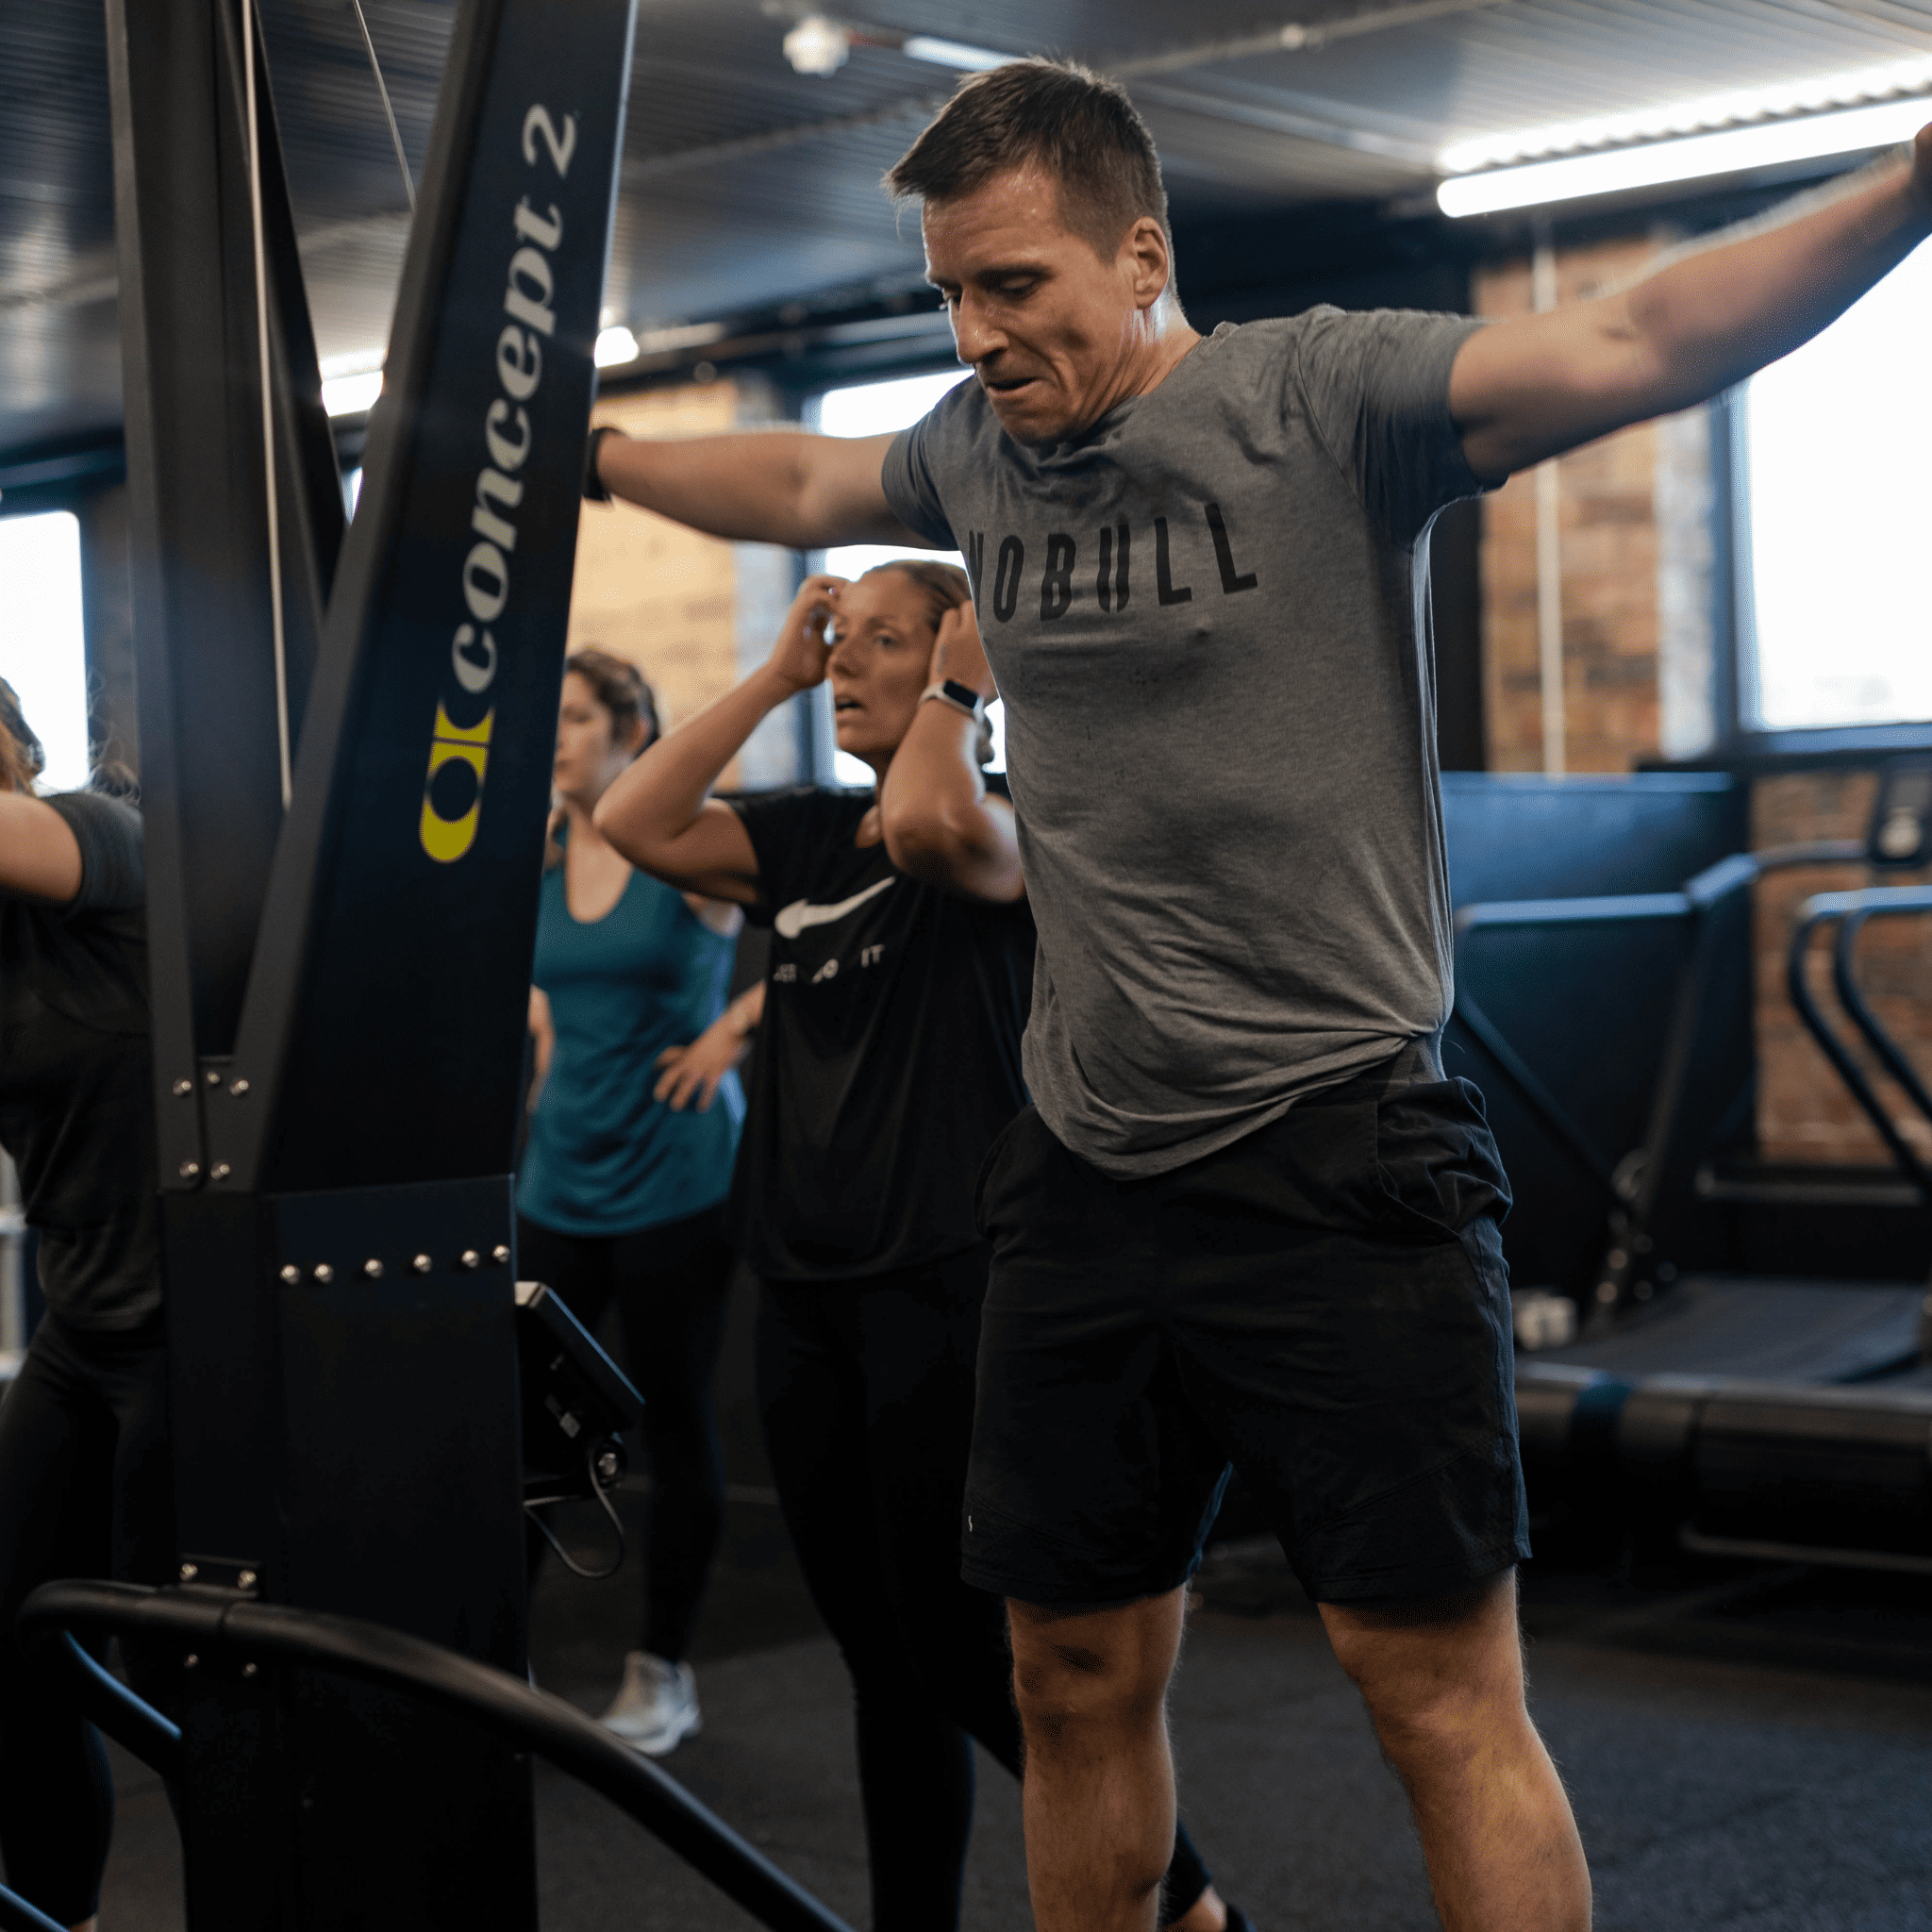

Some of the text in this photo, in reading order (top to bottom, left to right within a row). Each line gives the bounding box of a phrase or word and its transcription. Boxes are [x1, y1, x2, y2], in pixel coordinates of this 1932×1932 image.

[452, 103, 577, 693] concept 2
[860, 943, 885, 968] IT
